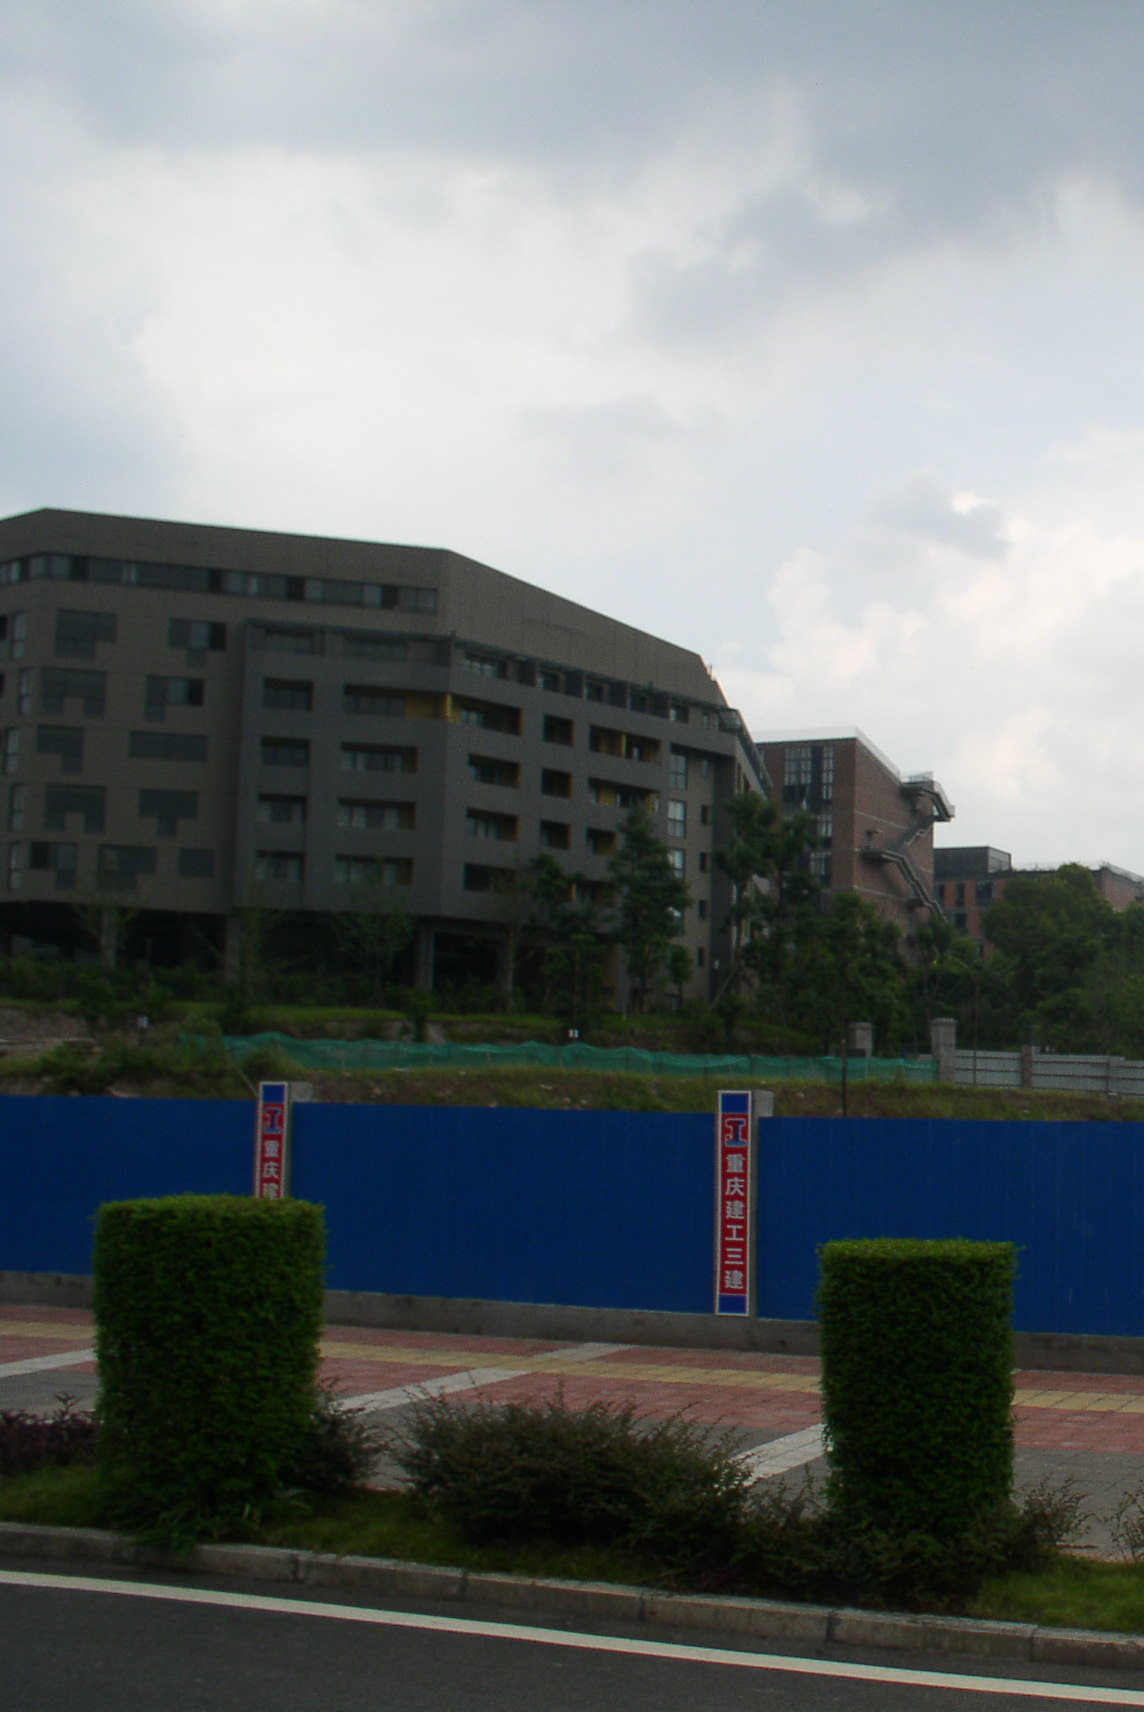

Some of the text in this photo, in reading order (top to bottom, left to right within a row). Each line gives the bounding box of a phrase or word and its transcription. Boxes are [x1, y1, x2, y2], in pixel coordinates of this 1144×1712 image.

[725, 1153, 745, 1289] 重庆建工三建
